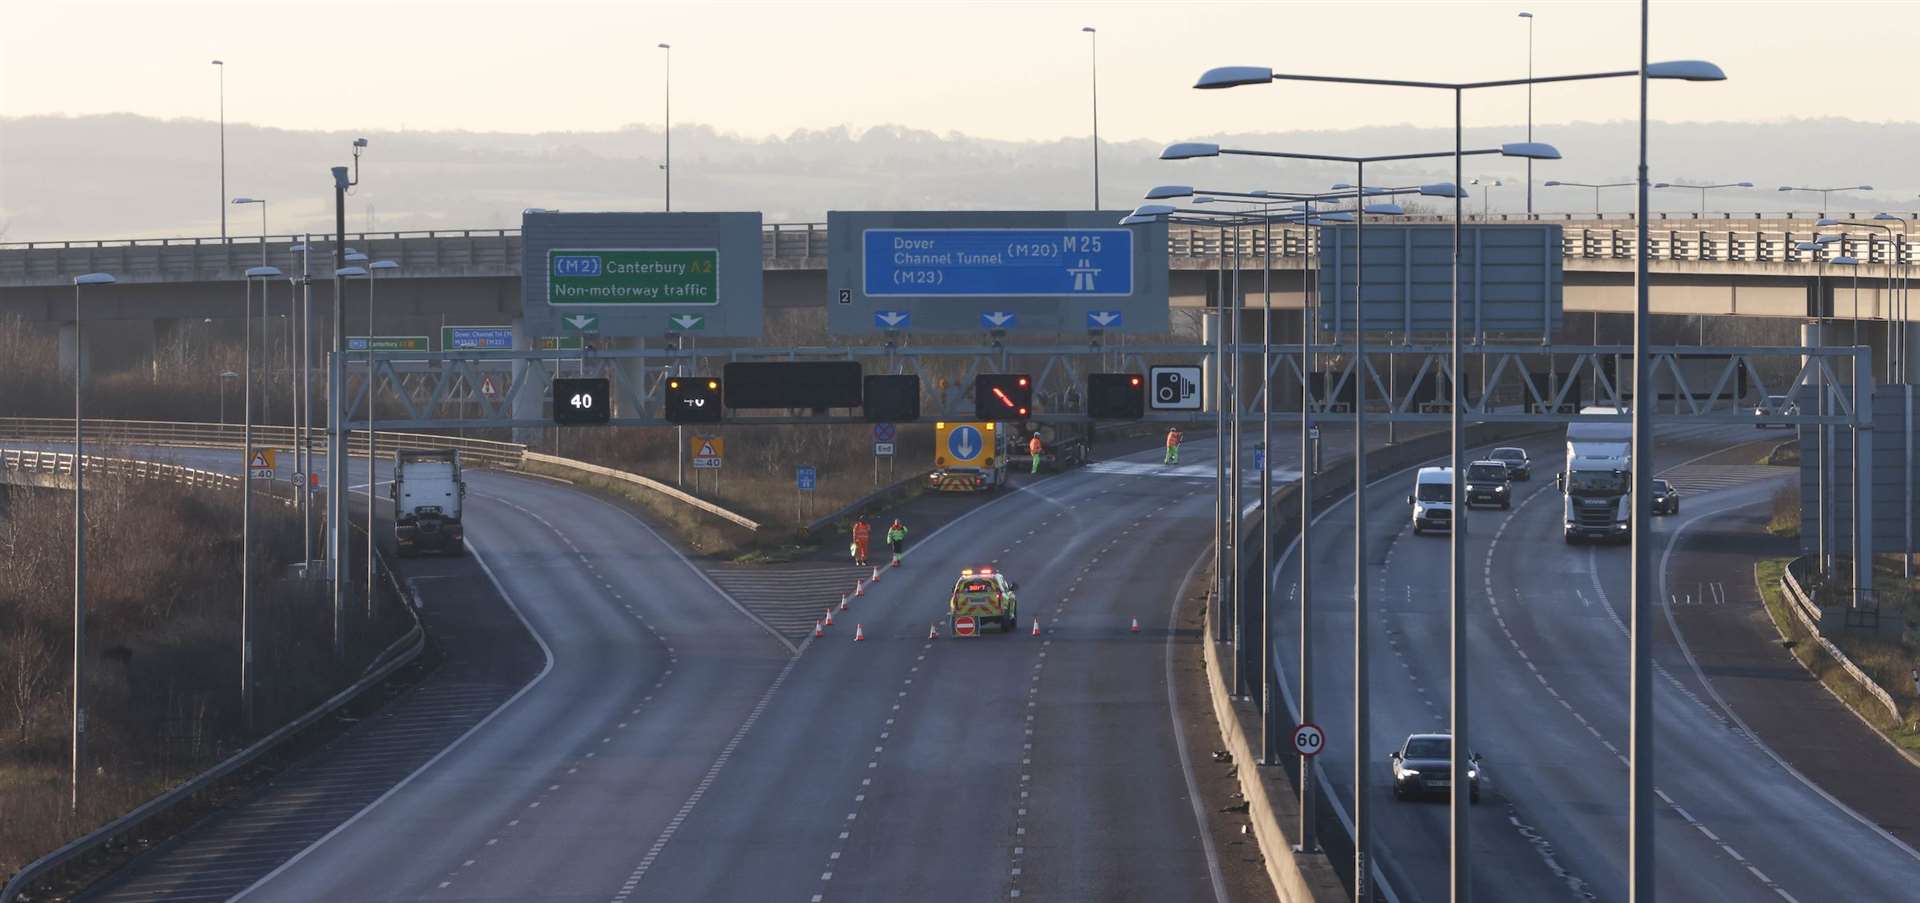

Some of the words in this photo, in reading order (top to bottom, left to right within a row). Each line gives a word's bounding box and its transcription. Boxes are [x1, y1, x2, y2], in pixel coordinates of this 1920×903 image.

[894, 237, 935, 249] Dover
[1007, 242, 1058, 258] (M20)
[894, 252, 951, 264] Channel
[957, 252, 1002, 264] Tunnel
[557, 259, 598, 274] (M2)
[606, 260, 687, 275] Canterbury
[691, 260, 712, 273] A2
[893, 269, 943, 285] (M23)
[555, 284, 658, 298] Non-motorway
[664, 284, 707, 296] traffic
[841, 292, 849, 302] 2
[570, 393, 592, 409] 40
[706, 458, 720, 467] 40
[258, 470, 272, 478] 40
[1297, 732, 1320, 748] 60
